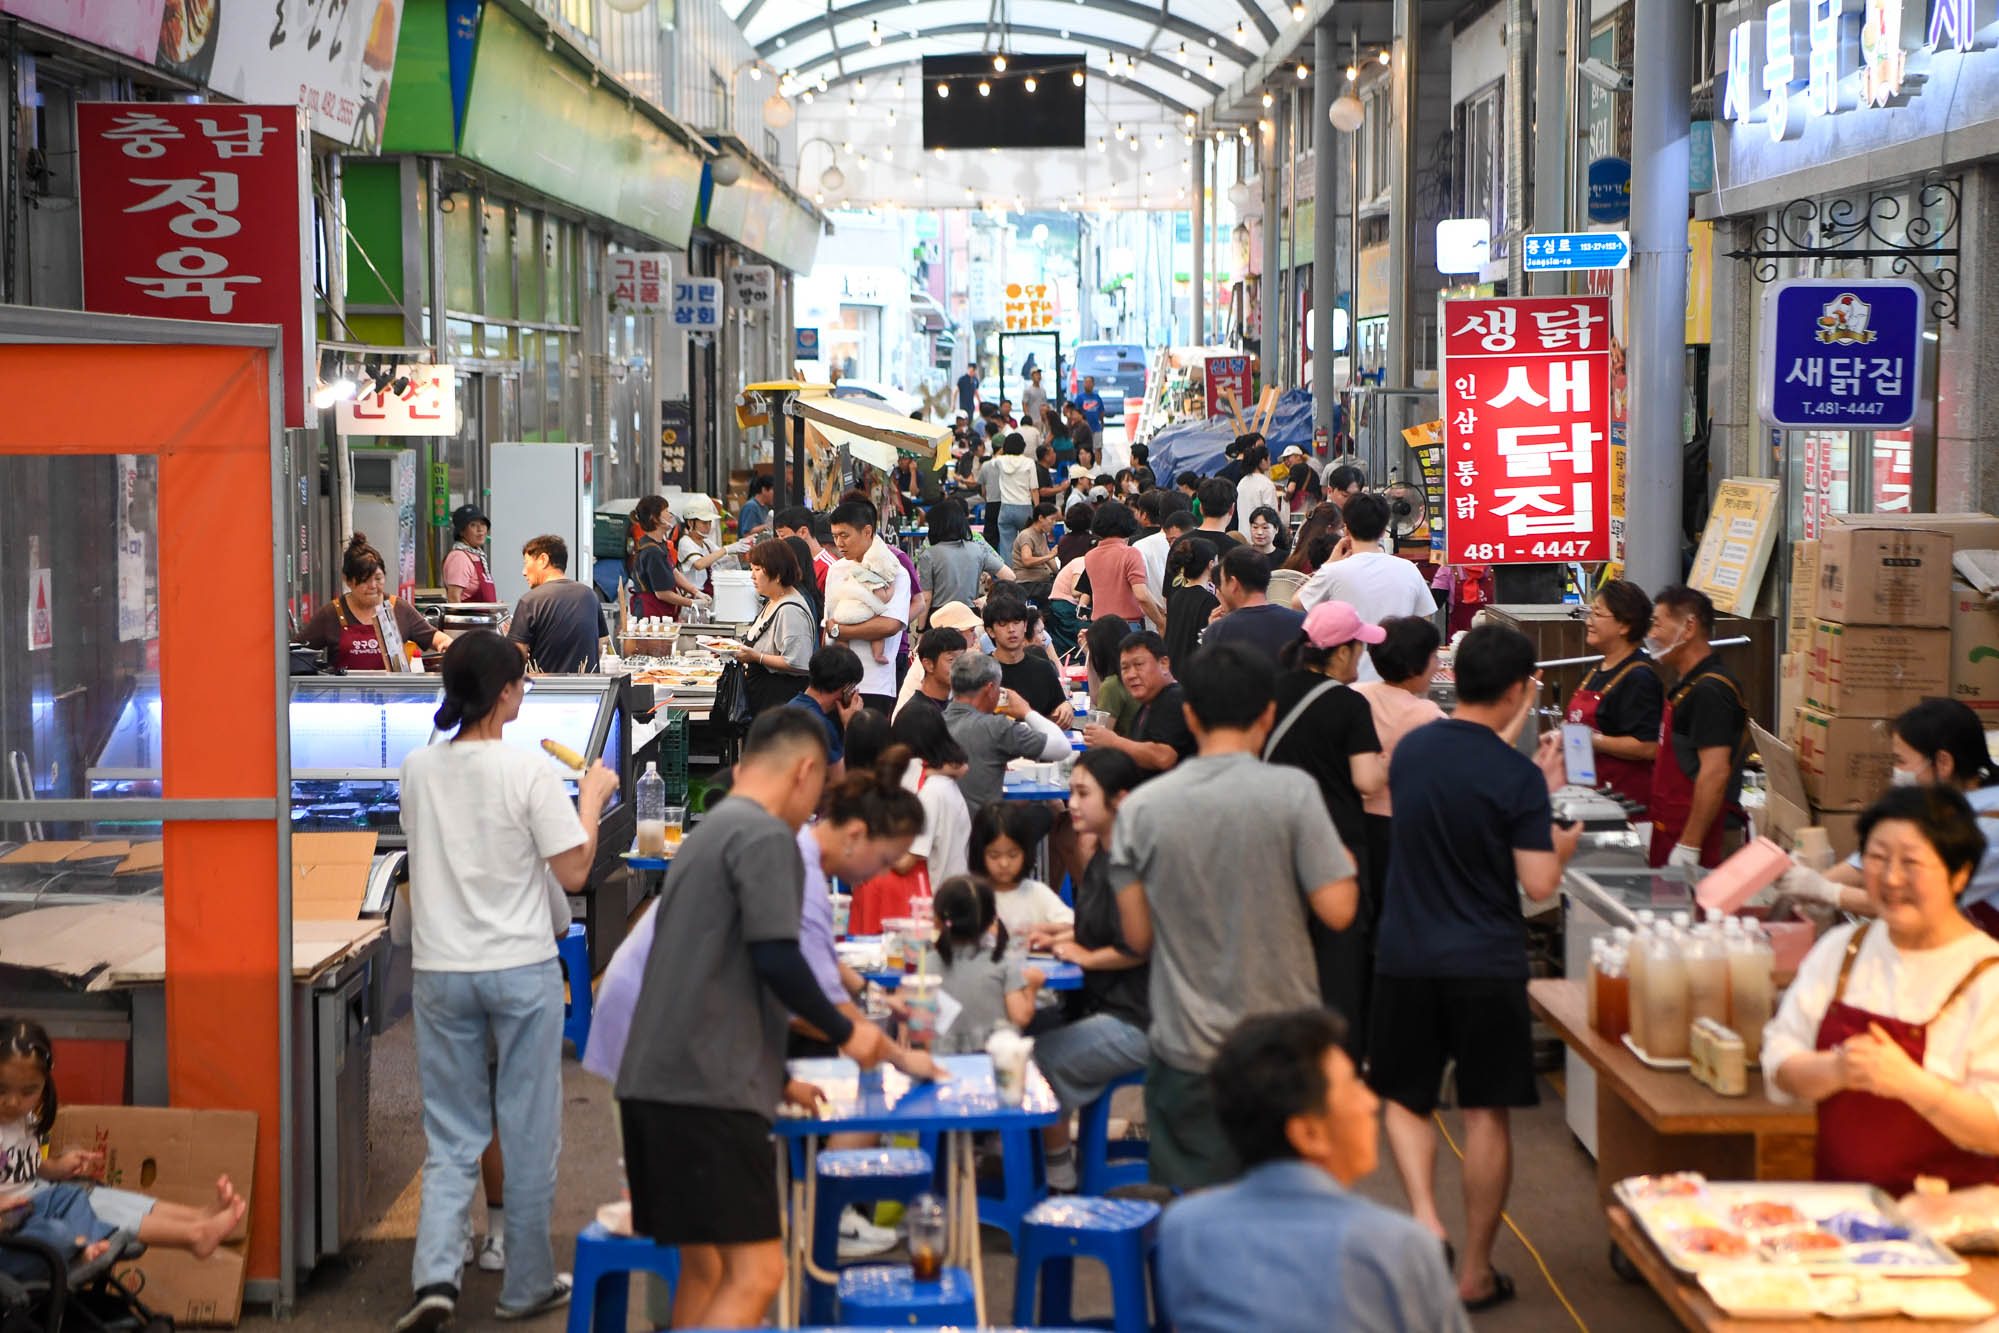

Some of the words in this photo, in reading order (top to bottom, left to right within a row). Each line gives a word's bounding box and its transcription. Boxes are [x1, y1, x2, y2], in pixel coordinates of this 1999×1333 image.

[101, 113, 278, 158] 충남
[123, 171, 261, 314] 정육
[1527, 239, 1571, 254] 중심로
[615, 260, 659, 280] 그린
[615, 283, 659, 303] 식품
[675, 285, 715, 302] 기린
[675, 306, 715, 324] 상회
[1452, 304, 1603, 351] 생닭
[1784, 357, 1904, 396] 새닭집
[1802, 402, 1884, 415] T.481-4447
[1485, 360, 1603, 537] 새닭집
